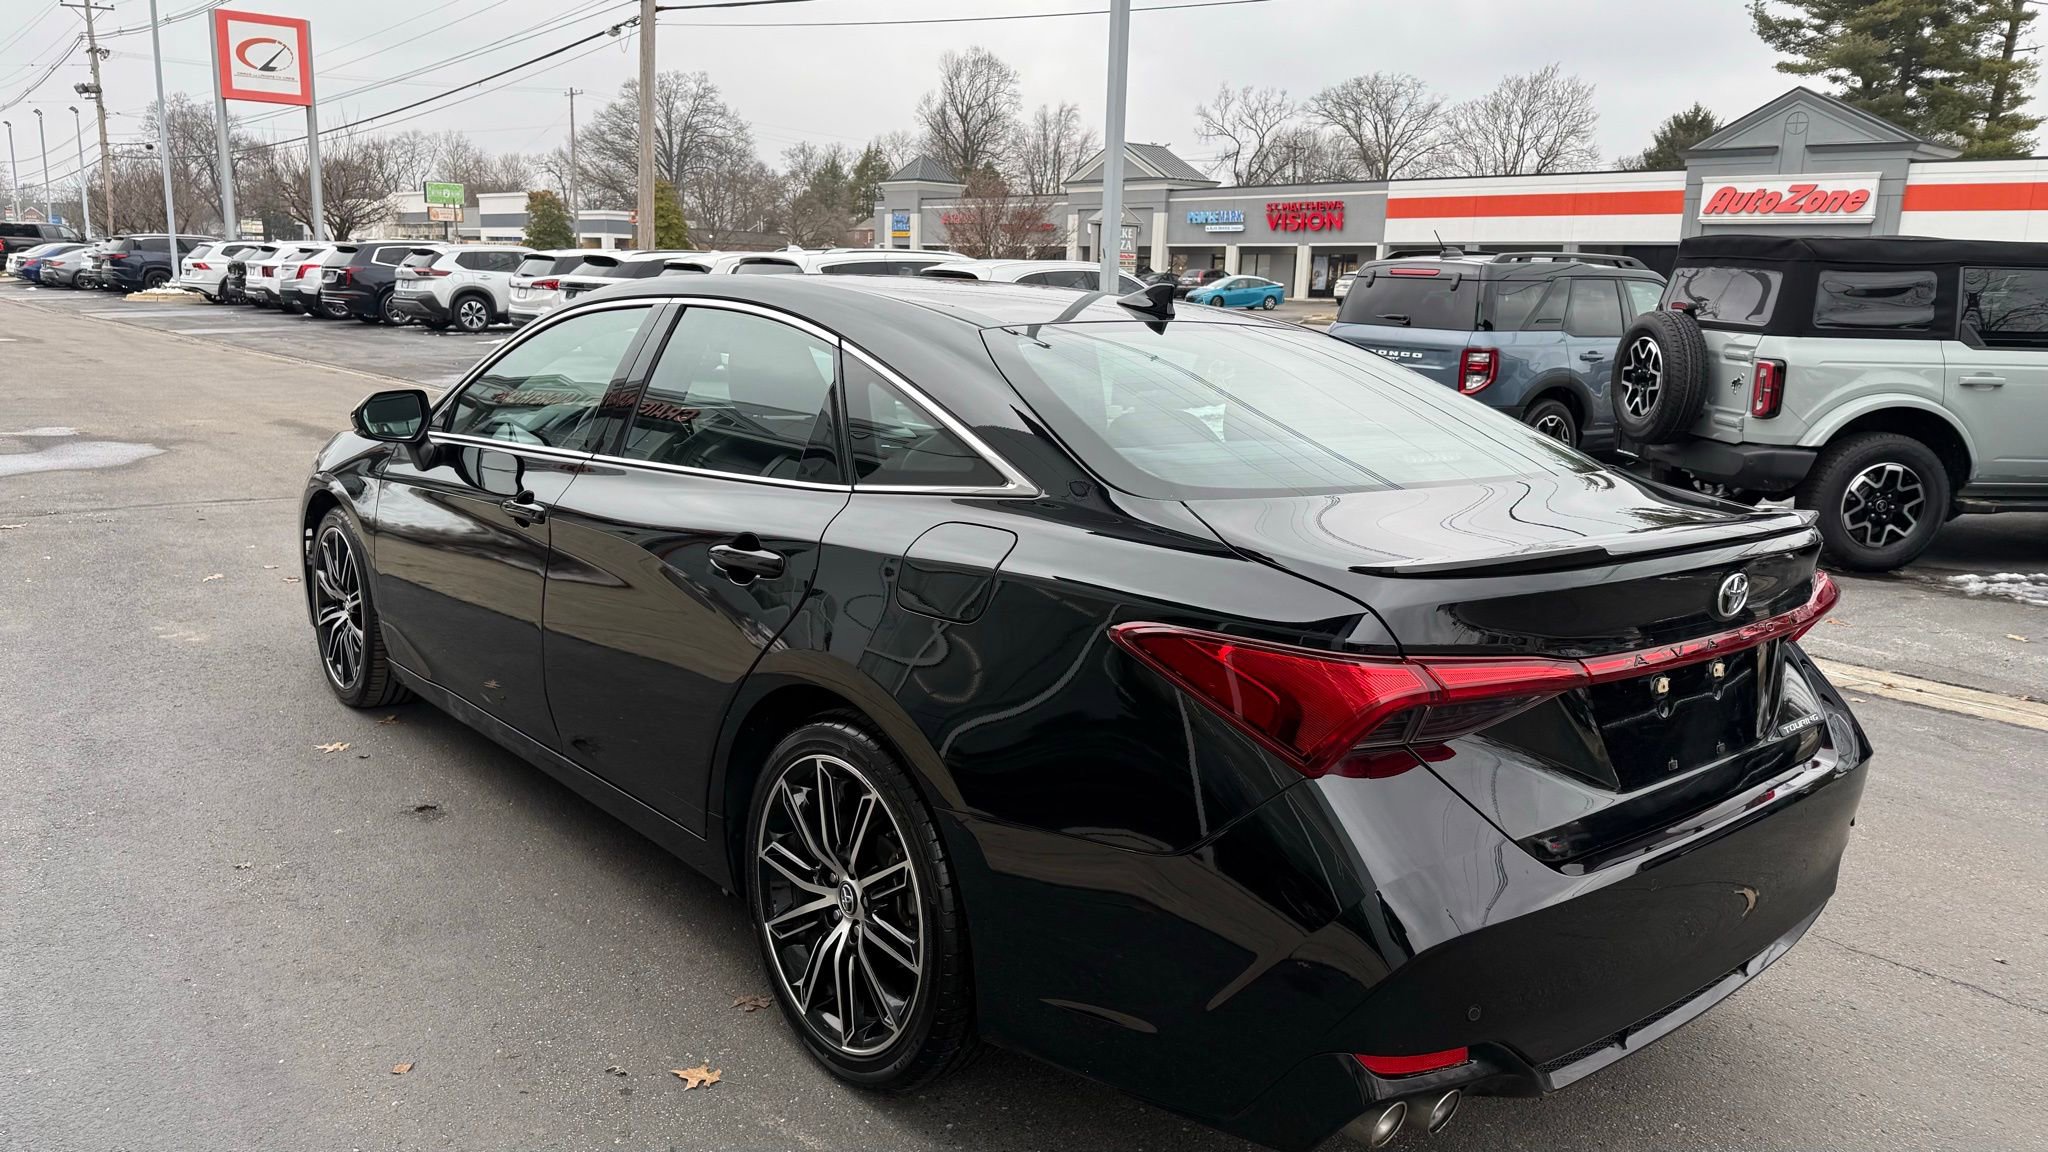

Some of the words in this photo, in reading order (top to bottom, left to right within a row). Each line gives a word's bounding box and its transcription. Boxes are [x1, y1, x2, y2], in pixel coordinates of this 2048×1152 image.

[1282, 200, 1344, 212] MATTHEWS
[1703, 184, 1870, 214] AutoZone
[1266, 212, 1344, 232] VISION
[1633, 611, 1799, 667] AVALON
[1783, 713, 1819, 734] TOURING
